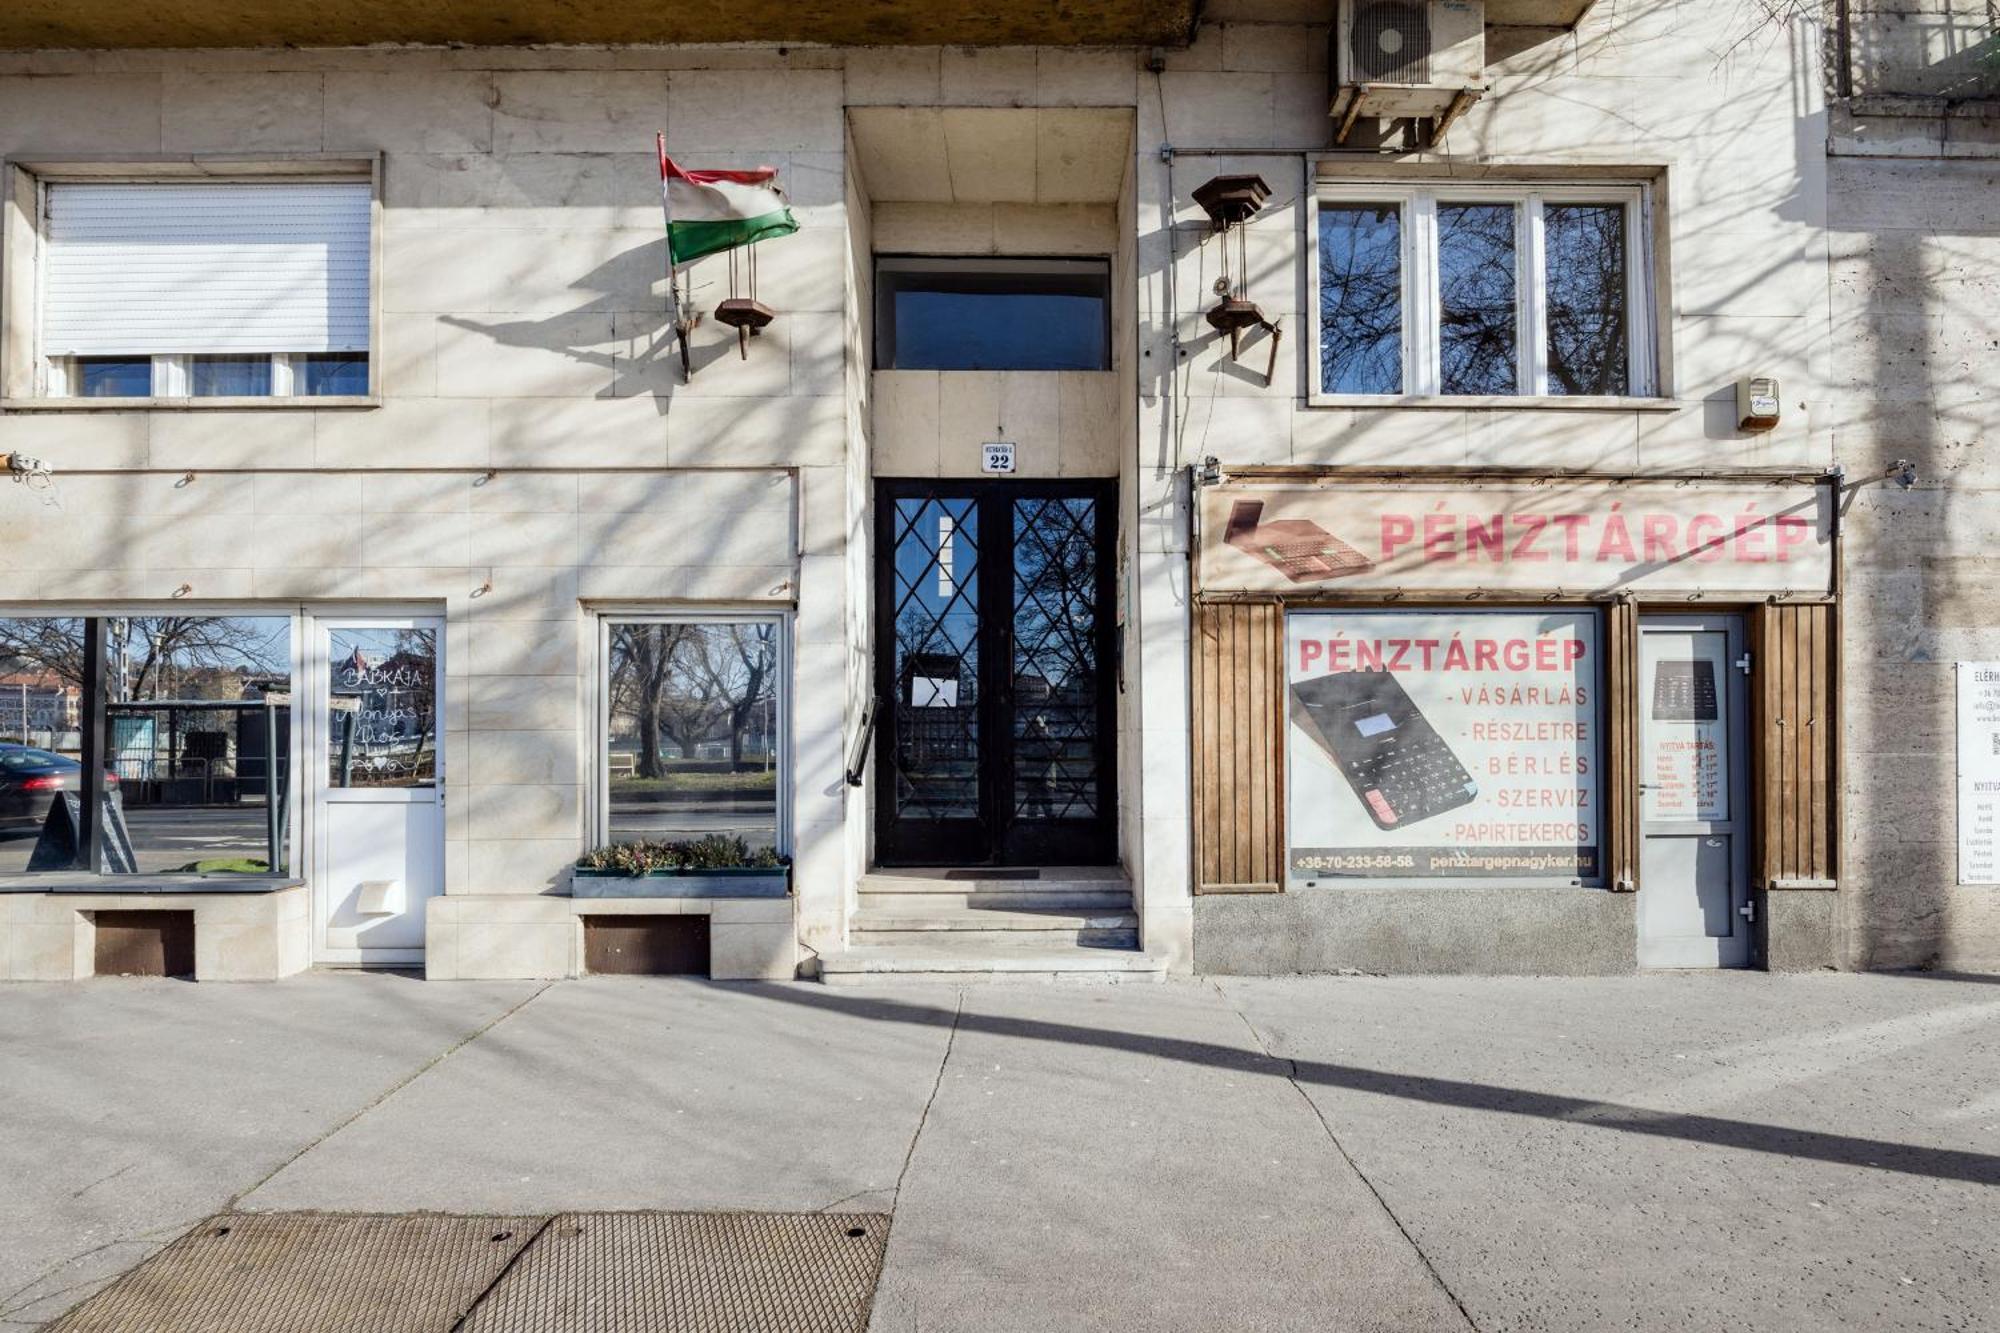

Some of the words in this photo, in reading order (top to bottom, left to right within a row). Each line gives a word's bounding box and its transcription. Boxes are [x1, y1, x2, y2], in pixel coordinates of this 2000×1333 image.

[990, 454, 1009, 469] 22
[1380, 502, 1808, 563] PÉNZTÁRGÉP
[1299, 631, 1587, 672] PÉNZTÁRGÉP
[1461, 683, 1588, 705] VÁSÁRLÁS
[1473, 719, 1588, 741] RÉSZLETRE
[1488, 751, 1589, 775] BÉRLÉS
[1497, 788, 1589, 808] SZERVIZ
